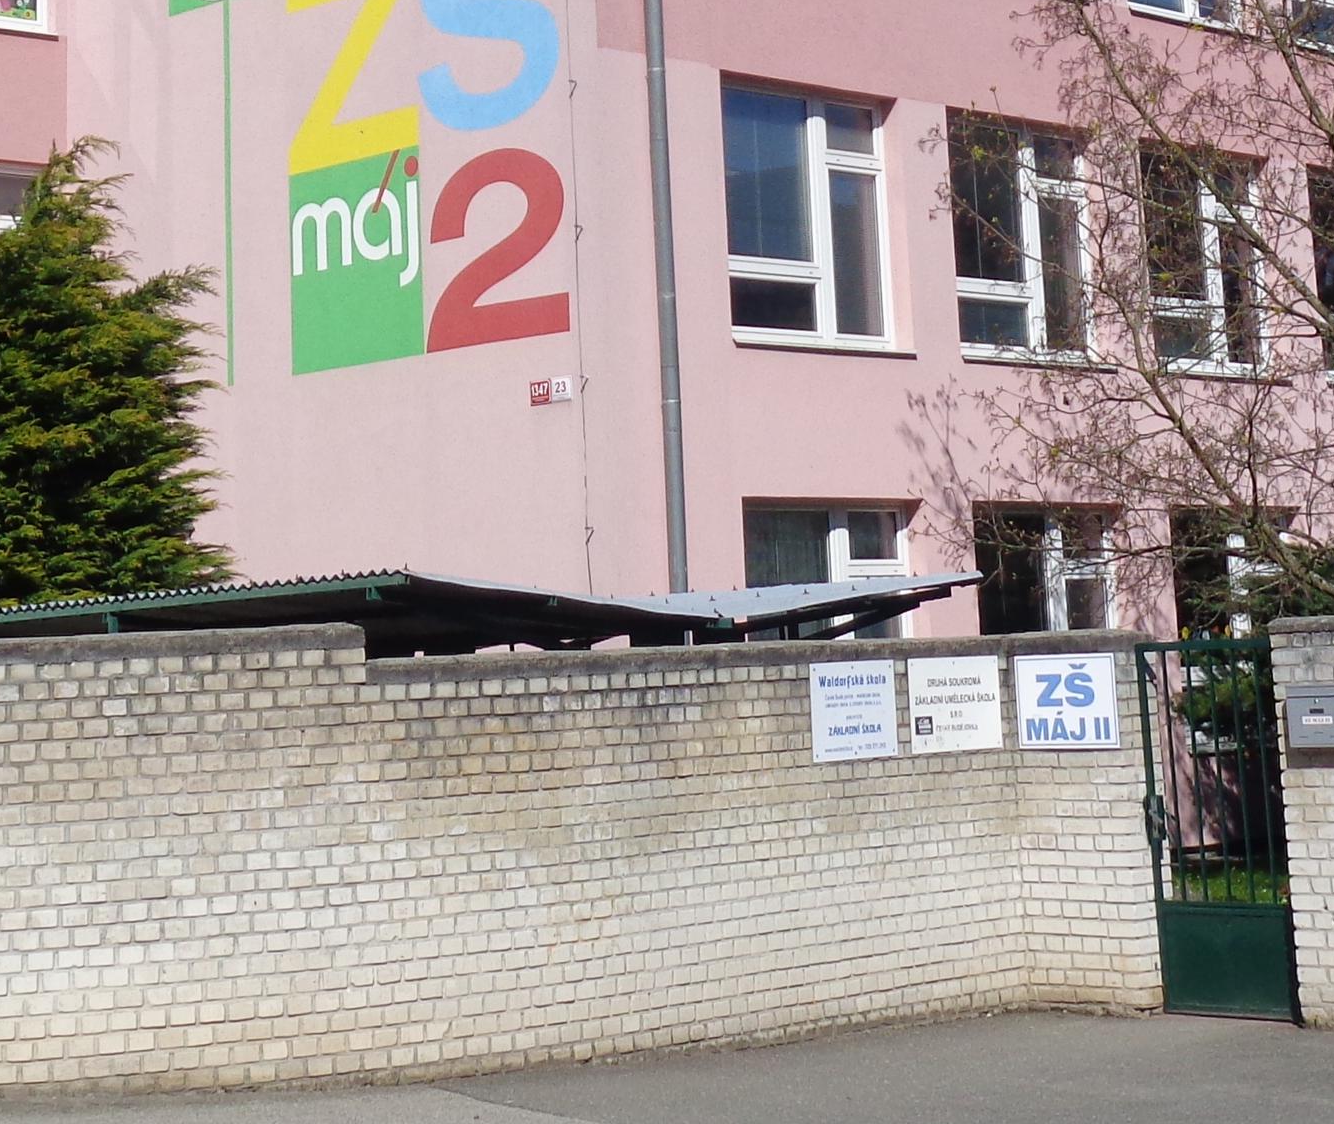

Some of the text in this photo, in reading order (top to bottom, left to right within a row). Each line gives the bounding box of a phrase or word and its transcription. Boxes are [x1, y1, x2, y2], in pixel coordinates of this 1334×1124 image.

[291, 148, 571, 354] máj 2
[531, 383, 548, 396] 1347
[555, 381, 566, 393] 23
[818, 673, 886, 689] Waldorfská škola
[1035, 663, 1095, 707] ZŠ
[977, 691, 996, 703] ŠKOLA
[828, 722, 882, 736] ZÁKLADNÍ ŠKOLA
[1026, 711, 1110, 741] MÁJ II
